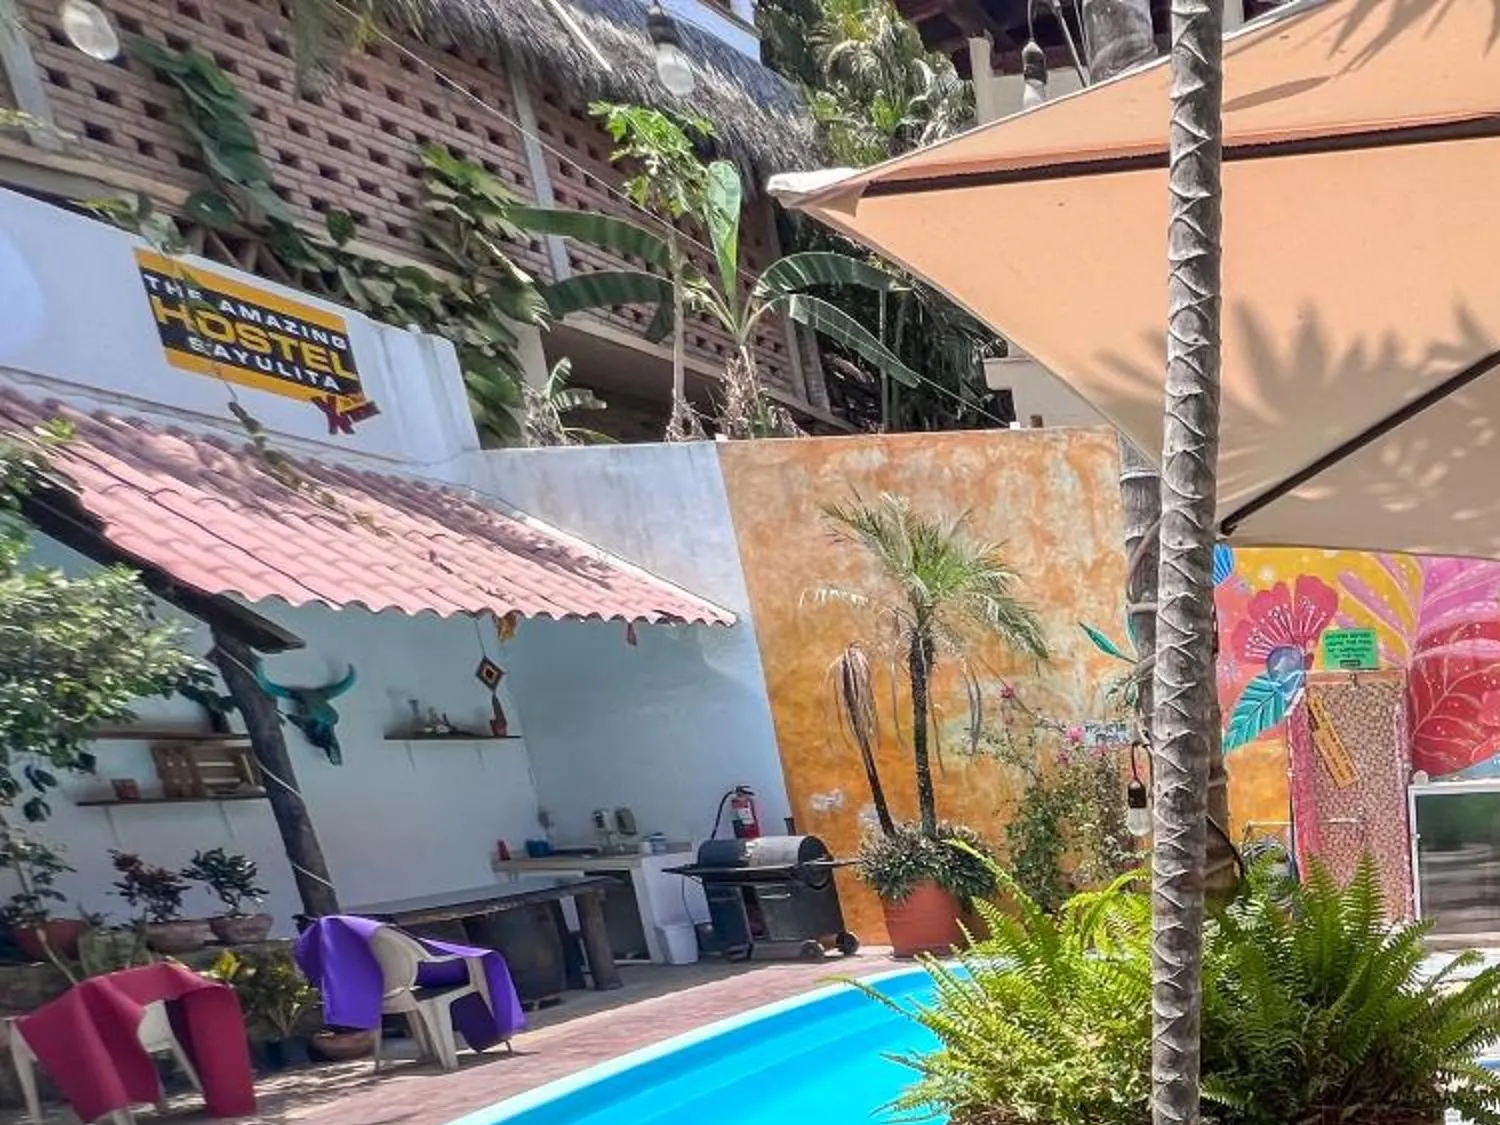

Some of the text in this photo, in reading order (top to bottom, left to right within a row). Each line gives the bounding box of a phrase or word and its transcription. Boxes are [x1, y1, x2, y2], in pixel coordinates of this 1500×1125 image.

[142, 273, 347, 350] THE AMAZING
[149, 293, 359, 382] HOSTEL
[187, 336, 341, 391] SAYULITA
